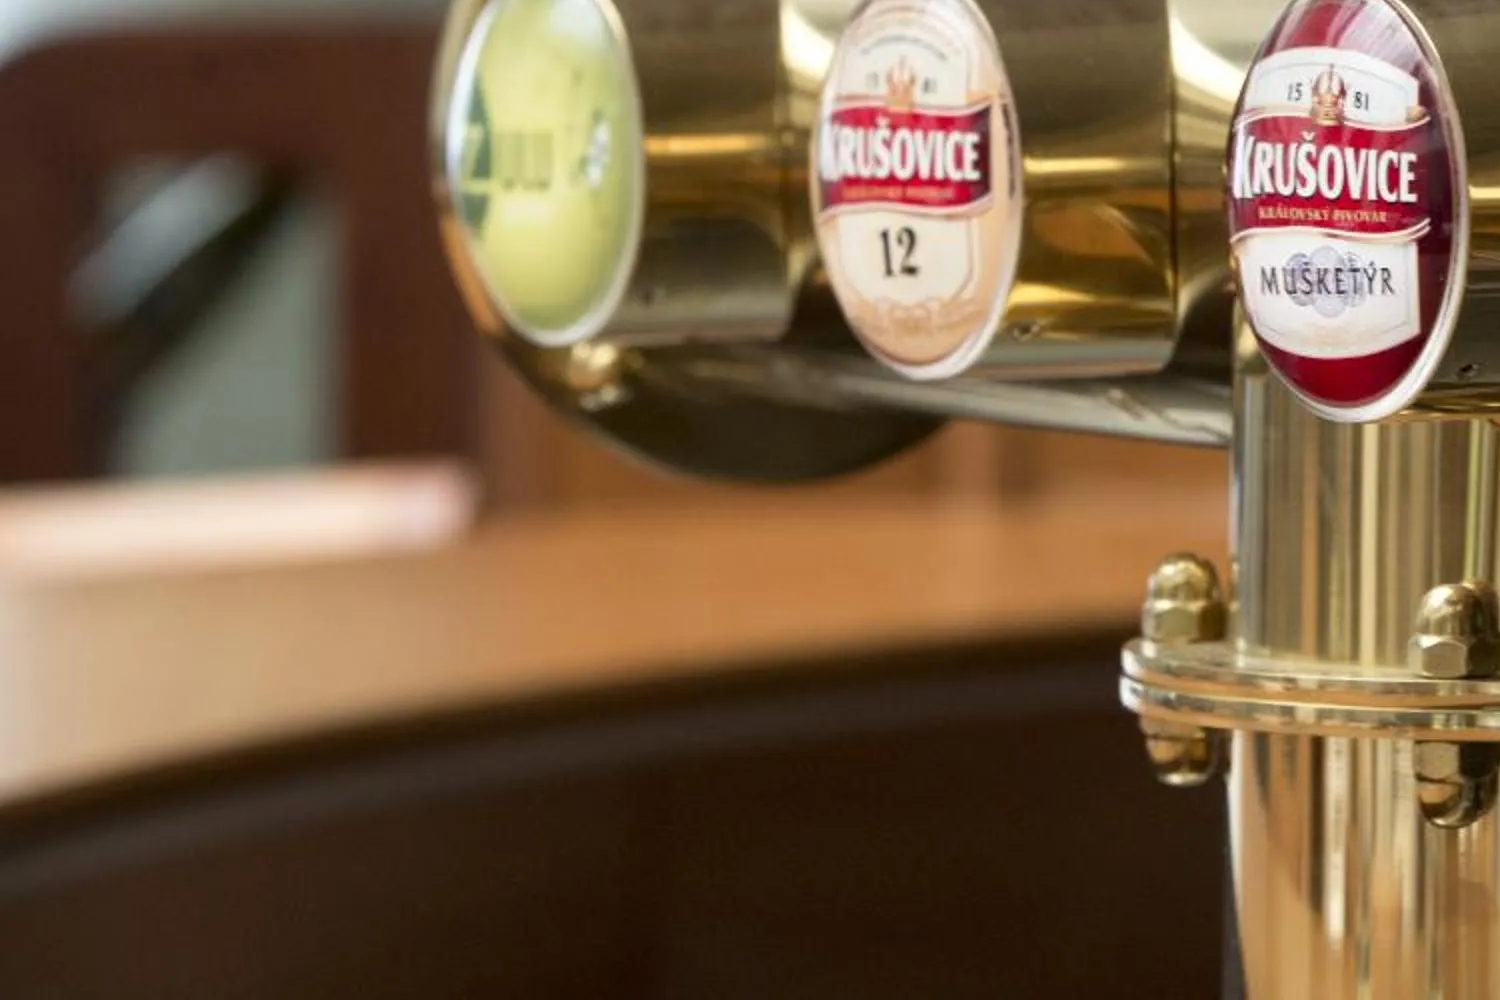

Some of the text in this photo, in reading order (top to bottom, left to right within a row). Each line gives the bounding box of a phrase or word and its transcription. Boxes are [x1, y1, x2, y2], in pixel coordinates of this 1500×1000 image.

[1286, 82, 1370, 111] 15 81
[820, 115, 981, 183] KRUŠOVICE
[1233, 130, 1418, 203] KRUŠOVICE
[878, 226, 919, 278] 12
[1260, 260, 1395, 295] MUŠKETÝR
